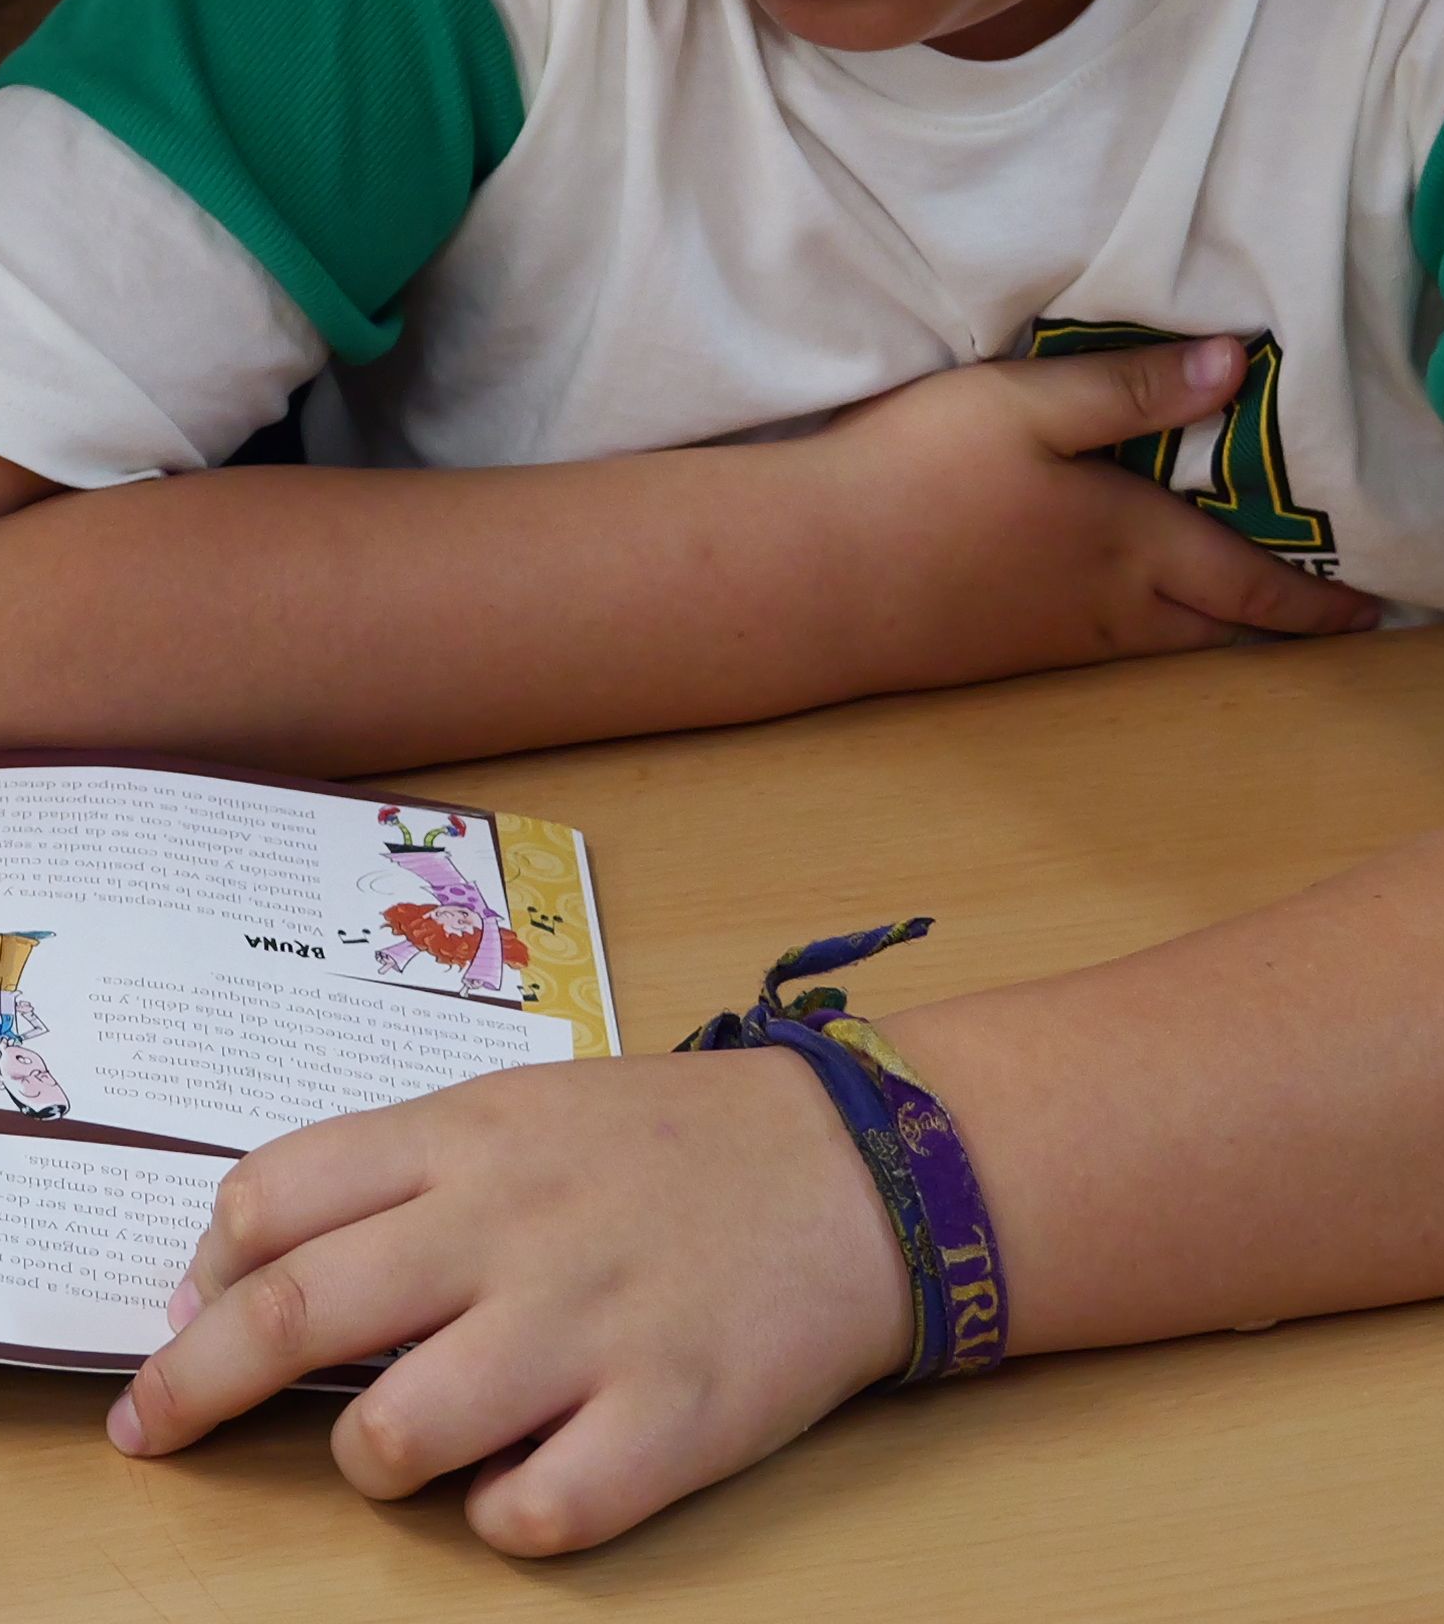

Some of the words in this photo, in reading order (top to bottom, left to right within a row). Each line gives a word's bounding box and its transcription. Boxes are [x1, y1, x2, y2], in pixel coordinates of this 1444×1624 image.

[48, 875, 101, 885] moral
[128, 881, 170, 892] sube
[19, 890, 87, 903] fiestera
[196, 890, 242, 905] ¡pero
[221, 911, 275, 929] Bruna
[243, 934, 327, 959] BRUNA
[101, 1166, 129, 1182] los
[135, 1171, 160, 1186] de
[104, 1188, 126, 1197] es
[36, 1199, 67, 1210] ser
[130, 1192, 176, 1209] todo
[74, 1204, 118, 1217] para
[65, 1220, 109, 1236] muy
[116, 1227, 128, 1239] y
[26, 1239, 101, 1256] engañe
[133, 1234, 188, 1253] tenaz
[10, 1256, 73, 1272] puede
[106, 1251, 125, 1265] te
[131, 1255, 157, 1265] no
[80, 1267, 97, 1282] le
[47, 1283, 58, 1291] a
